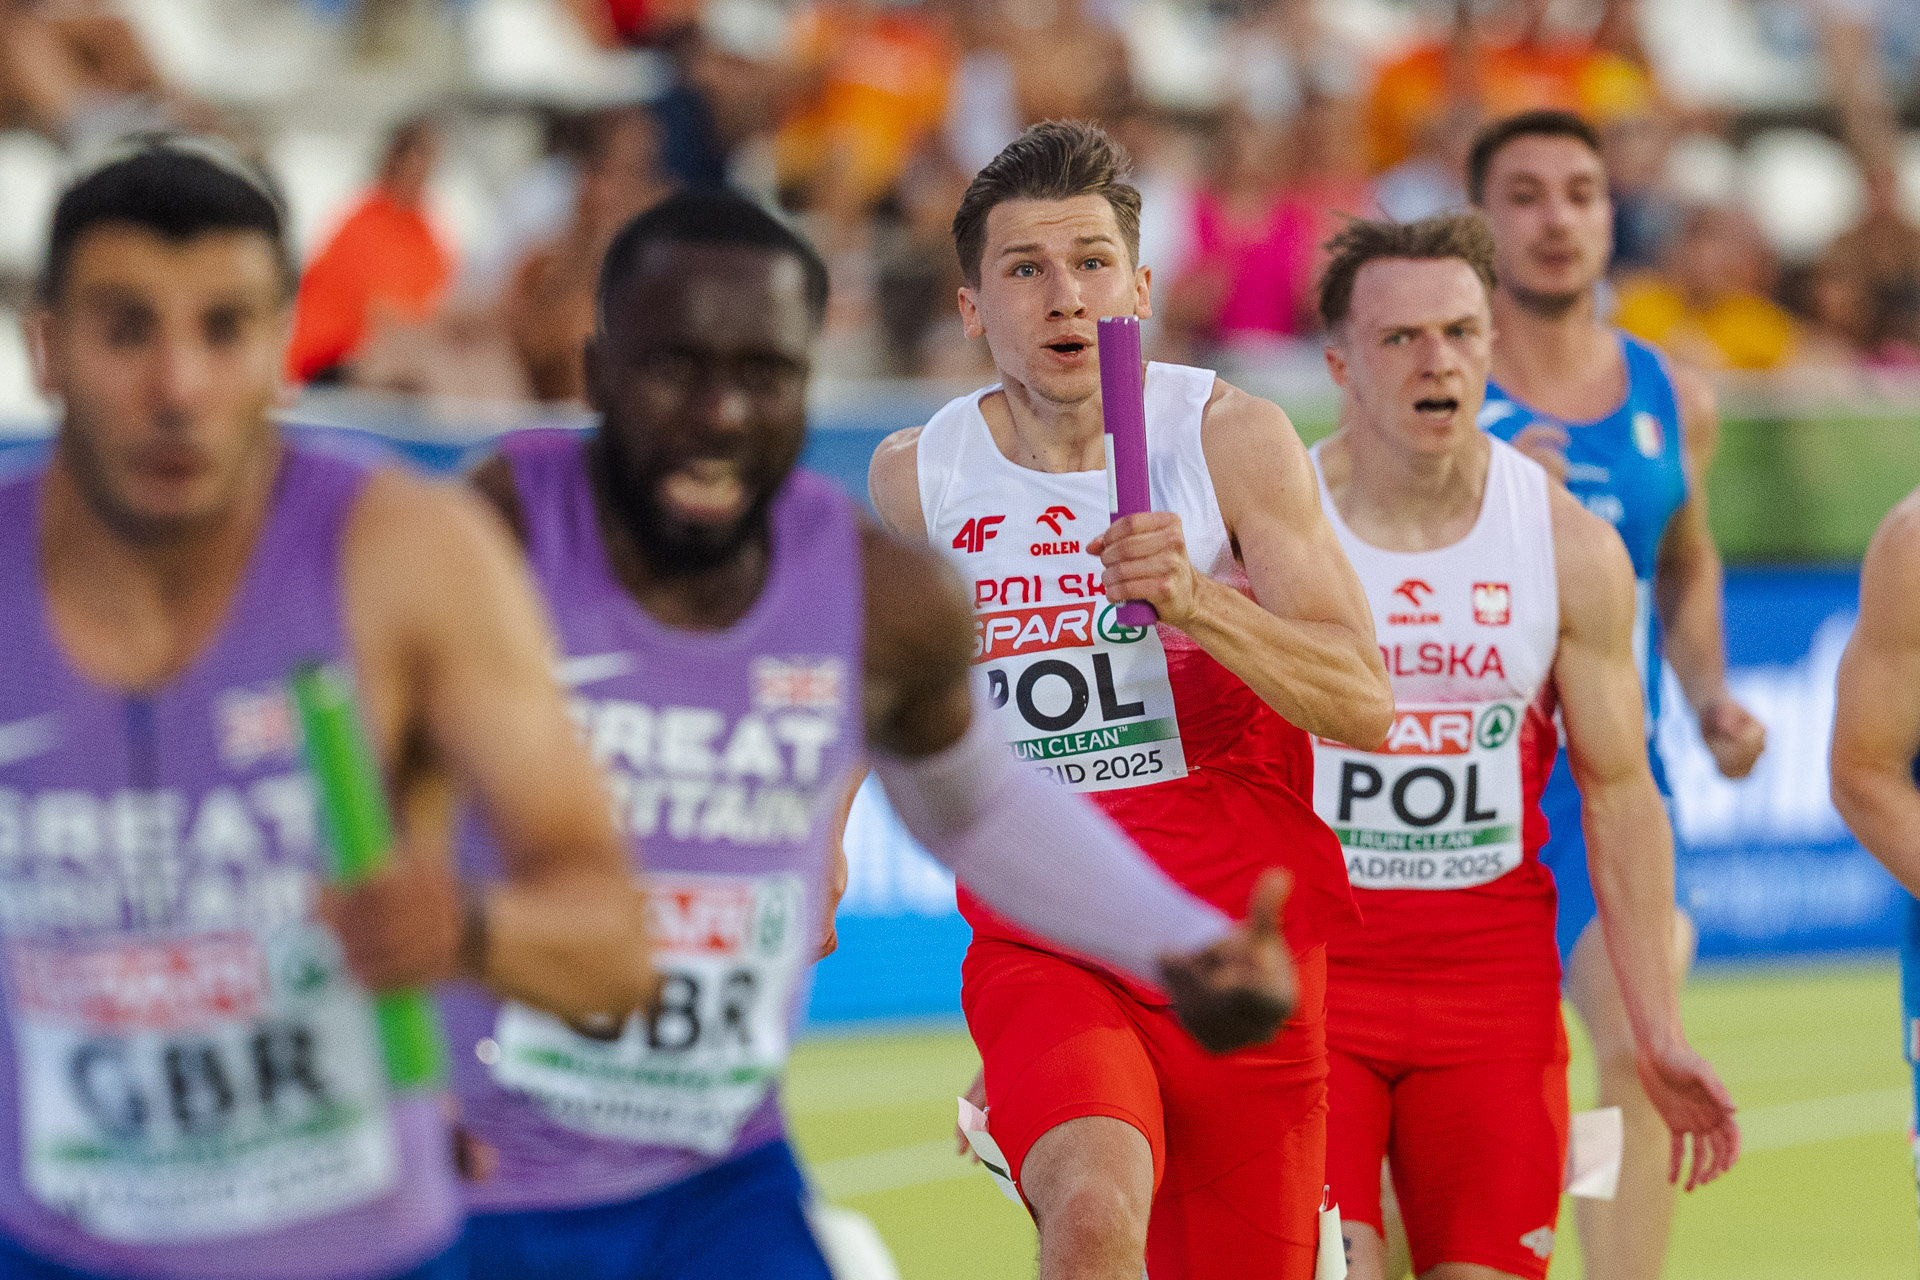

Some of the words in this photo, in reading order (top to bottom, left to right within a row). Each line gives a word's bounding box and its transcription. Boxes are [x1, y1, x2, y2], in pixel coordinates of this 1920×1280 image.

[952, 515, 1006, 553] 4F
[1030, 541, 1080, 556] ORLEN
[1092, 749, 1163, 782] 2025
[1337, 761, 1497, 828] POL
[1349, 856, 1436, 880] ADRID
[1445, 853, 1502, 878] 2025
